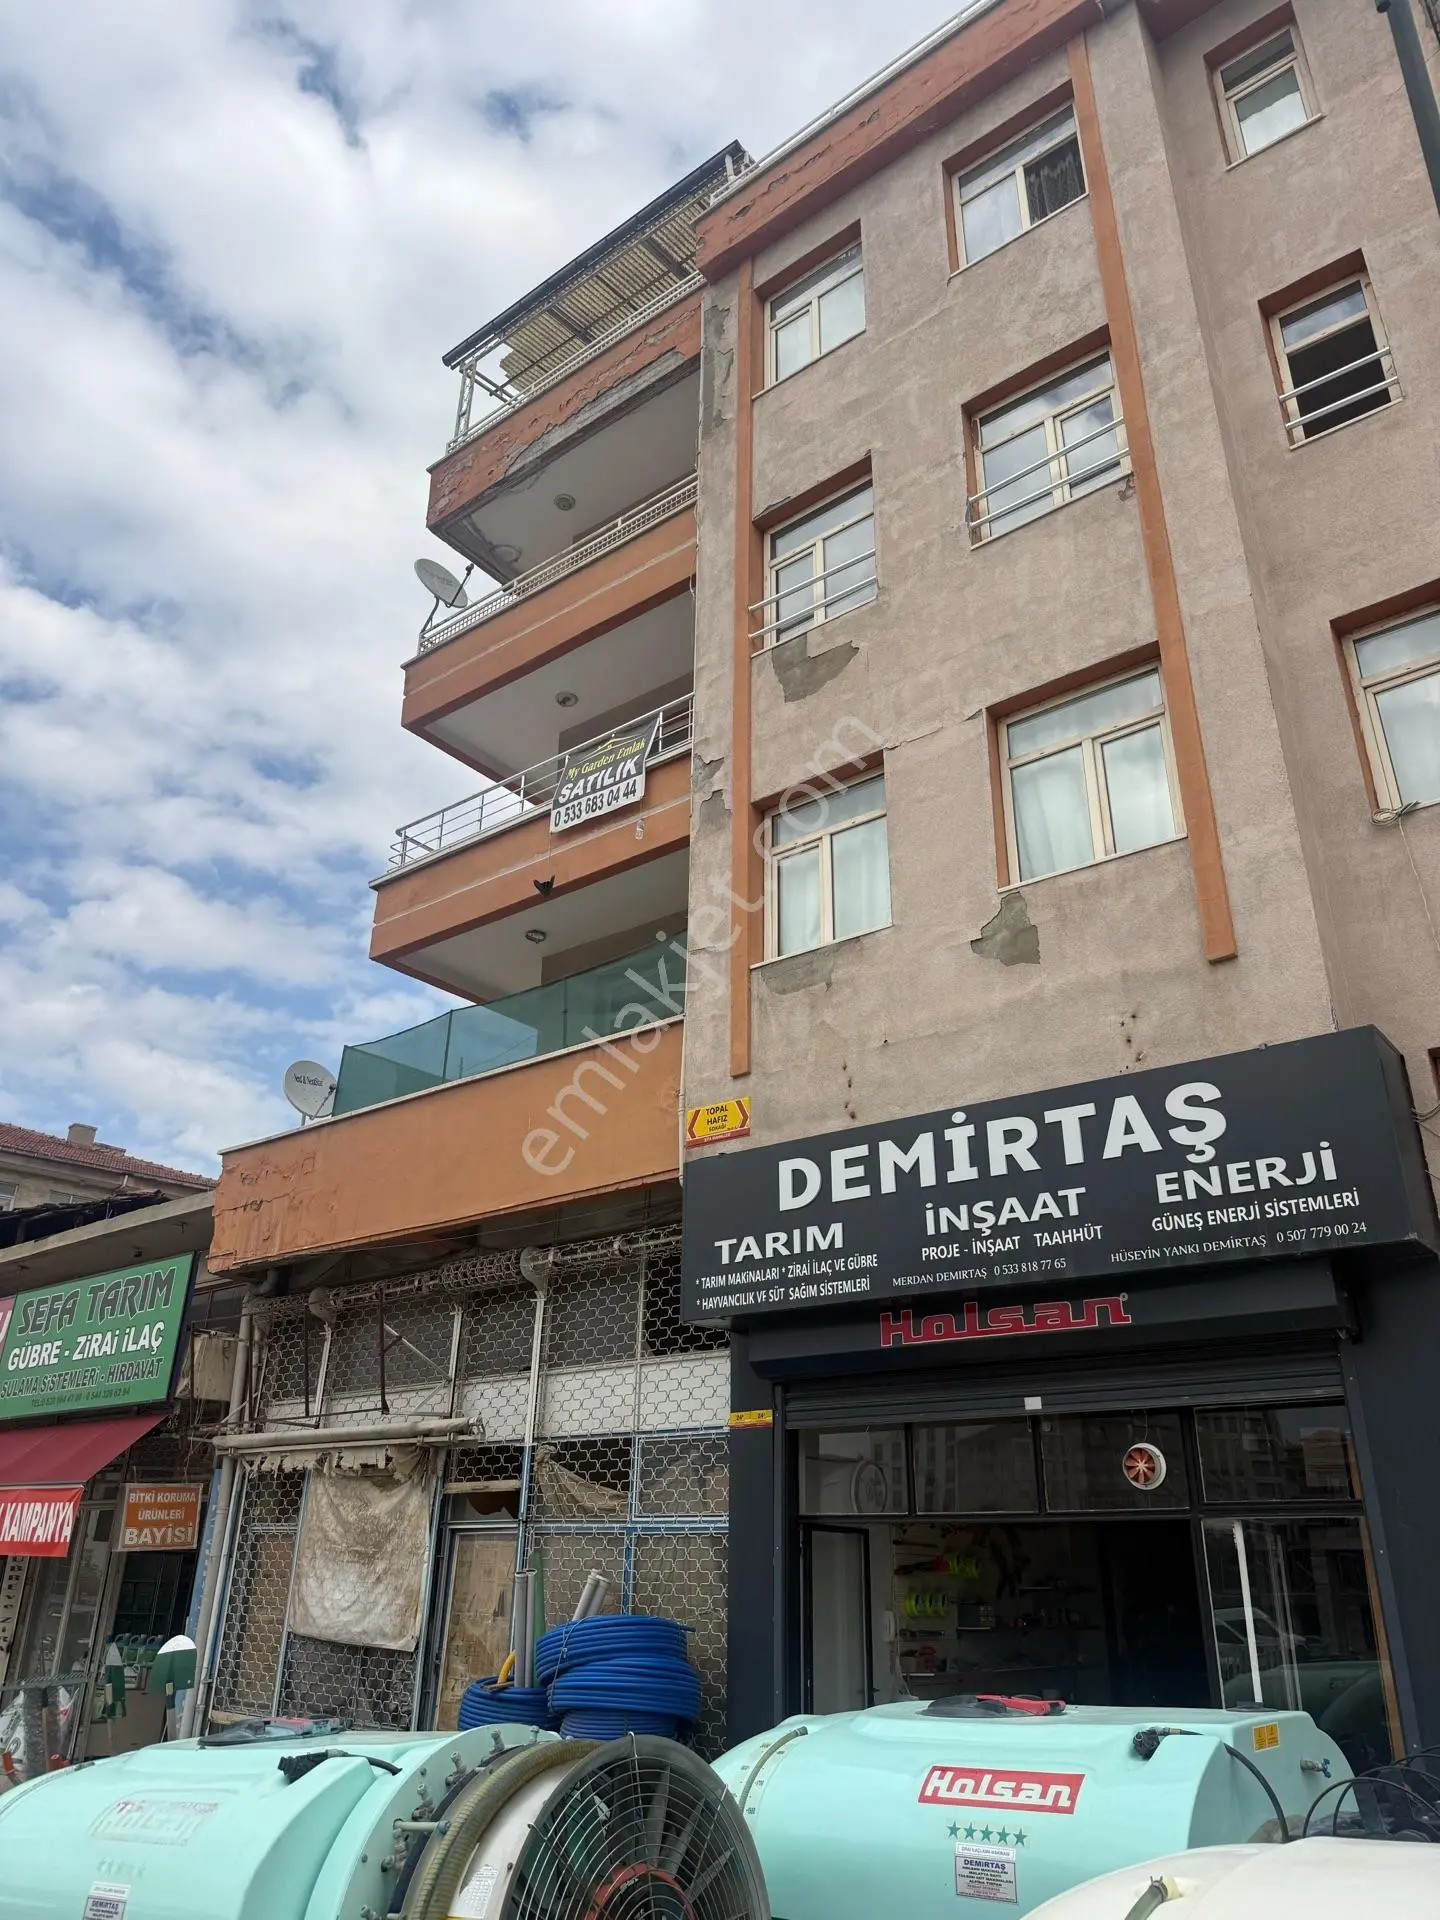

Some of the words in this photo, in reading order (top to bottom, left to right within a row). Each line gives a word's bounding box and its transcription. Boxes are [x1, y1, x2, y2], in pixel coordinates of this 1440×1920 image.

[581, 754, 615, 773] Garden
[616, 738, 645, 759] Emlak
[558, 754, 641, 803] SATILIK
[554, 810, 561, 827] 0
[564, 802, 582, 824] 533
[585, 793, 604, 814] 683
[607, 785, 620, 806] 04
[623, 779, 637, 799] 44
[706, 1105, 728, 1115] TOPAL
[778, 1081, 1227, 1212] DEMİRTAŞ
[1155, 1141, 1337, 1204] ENERJİ
[925, 1187, 1086, 1236] İNŞAAT
[1152, 1211, 1204, 1232] GÜNEŞ
[1207, 1200, 1261, 1226] ENERJİ
[1264, 1187, 1360, 1218] SİSTEMLERİ
[714, 1222, 843, 1265] TARIM
[921, 1243, 960, 1261] PROJE
[972, 1236, 1021, 1256] İNŞAAT
[1033, 1224, 1104, 1247] TAAHHÜT
[1111, 1246, 1160, 1263] HÜSEYİN
[1163, 1243, 1200, 1256] YANKI
[1203, 1234, 1267, 1252] DEMİRTAŞ
[1276, 1232, 1284, 1243] 0
[1286, 1229, 1307, 1241] 507
[1309, 1226, 1332, 1239] 779
[1334, 1223, 1349, 1236] 00
[1352, 1221, 1367, 1234] 24
[701, 1274, 726, 1289] TARIM
[834, 1258, 846, 1271] VE
[847, 1253, 878, 1270] GÜBRE
[892, 1273, 934, 1287] MERDAN
[994, 1265, 1000, 1276] 0
[1002, 1264, 1020, 1275] 533
[1021, 1262, 1039, 1273] 818
[1040, 1259, 1052, 1270] 77
[1054, 1258, 1067, 1269] 65
[17, 1289, 80, 1336] SEFA
[86, 1266, 177, 1325] TARIM
[702, 1291, 755, 1310] HAYVANCILIK
[769, 1285, 785, 1302] SÜT
[789, 1282, 818, 1300] SAĞIM
[880, 1297, 1132, 1348] Holsan
[8, 1340, 63, 1371] GÜBRE
[0, 1376, 38, 1399] SULAMA
[105, 1357, 164, 1385] HIRDAVAT
[157, 1492, 196, 1503] KORUMA
[0, 1502, 74, 1543] KAMPANYA
[924, 1770, 1071, 1807] Holsan
